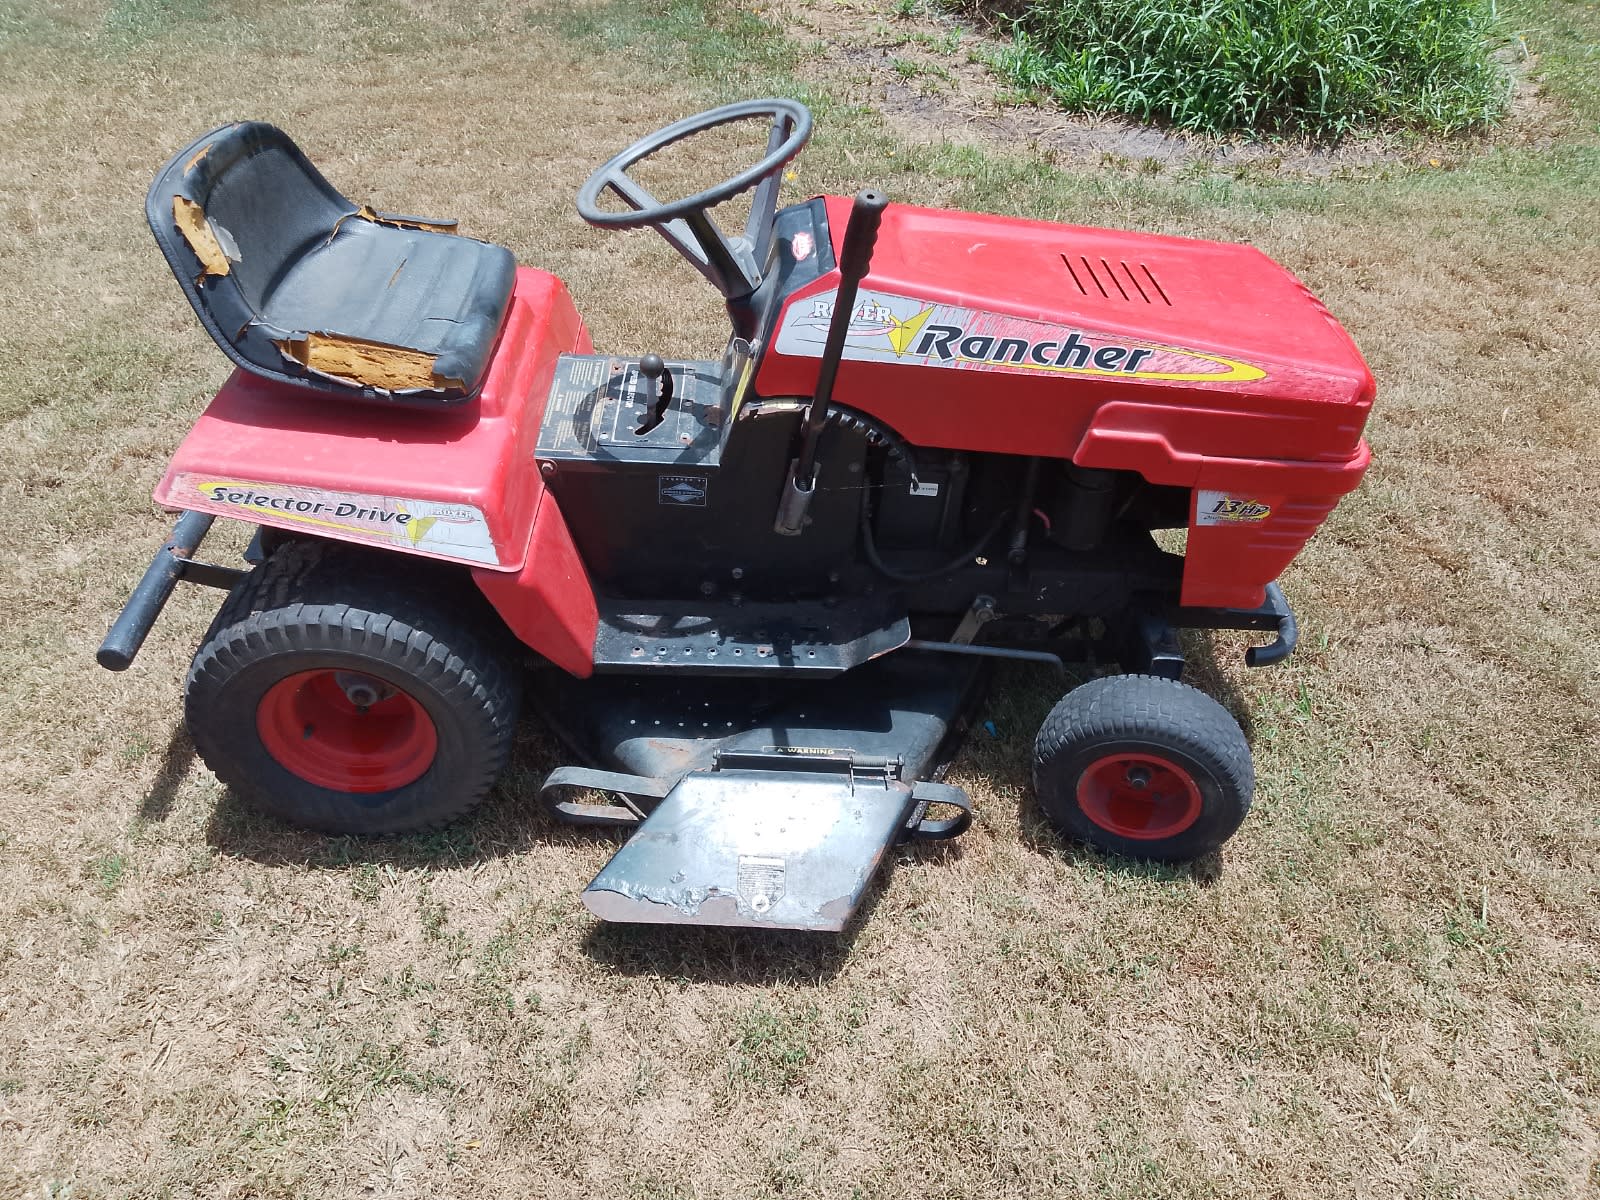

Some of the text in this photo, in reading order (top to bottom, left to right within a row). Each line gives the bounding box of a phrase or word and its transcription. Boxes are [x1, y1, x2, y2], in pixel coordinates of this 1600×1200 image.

[813, 301, 892, 326] RVER
[913, 324, 1152, 372] Rancher
[209, 486, 413, 525] Selector-Drive
[787, 747, 835, 755] WARNING
